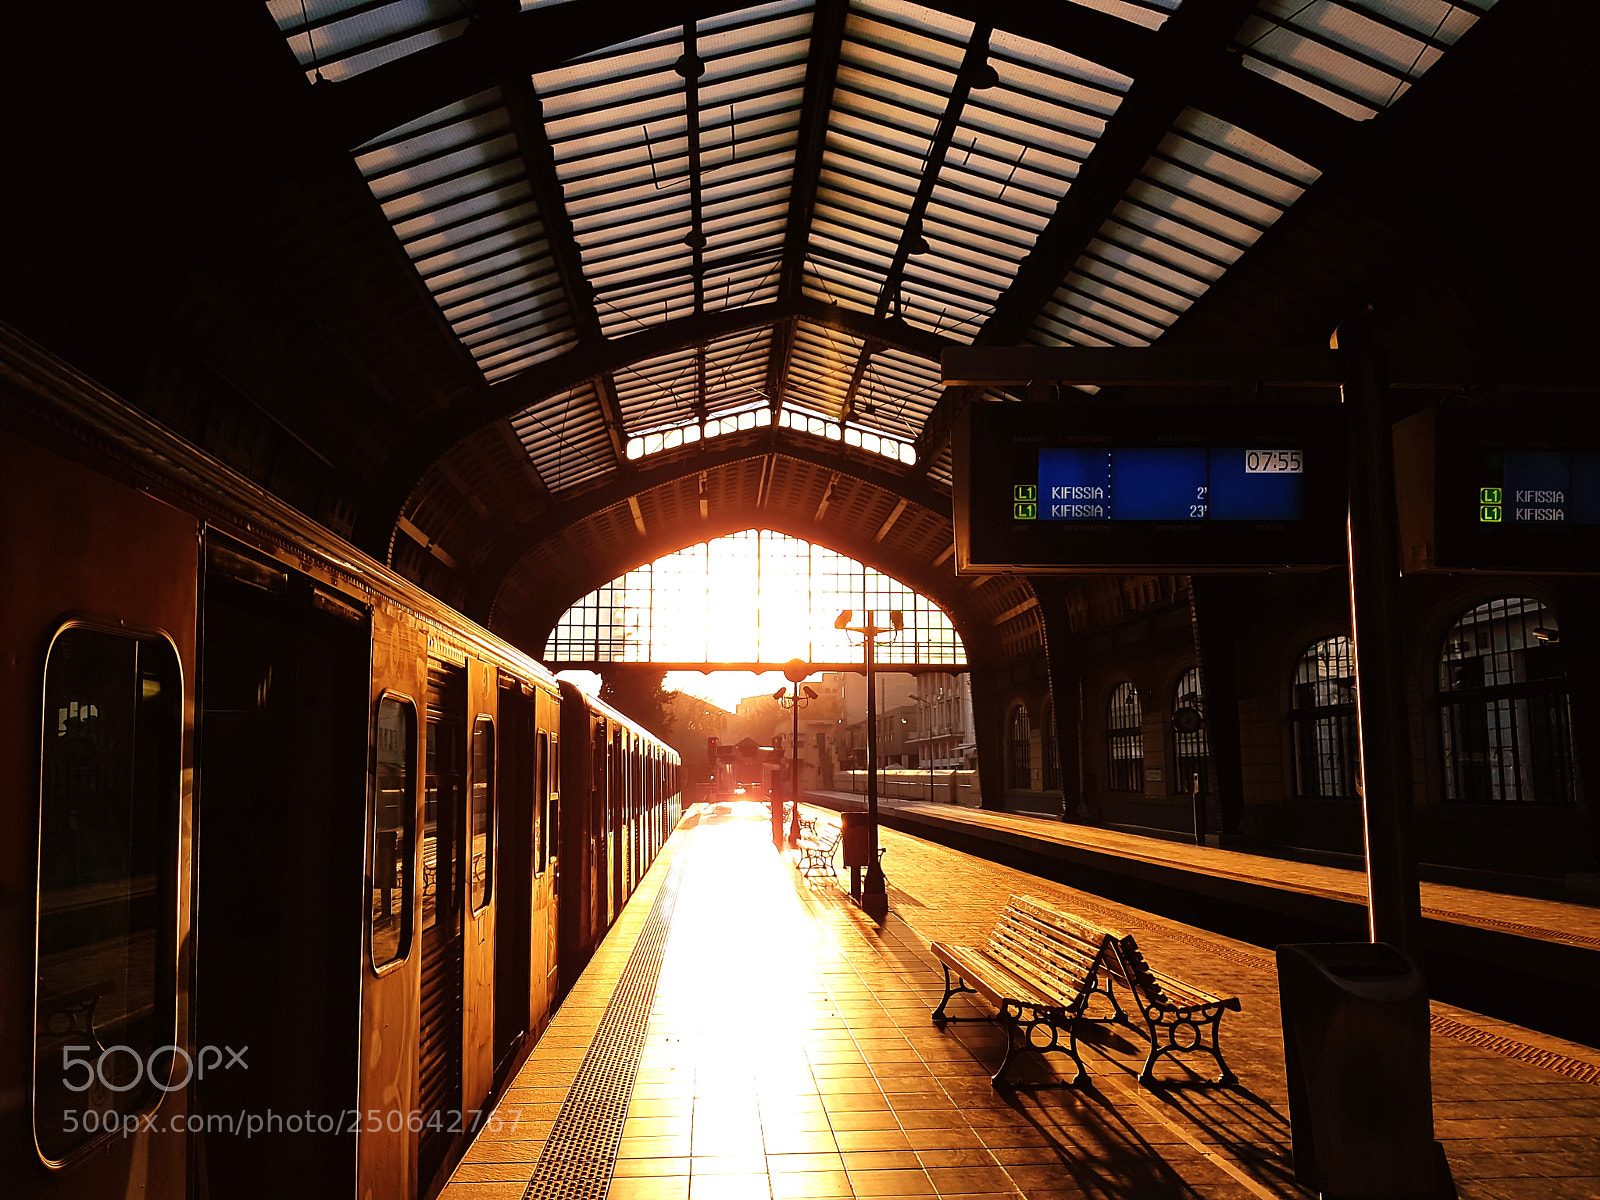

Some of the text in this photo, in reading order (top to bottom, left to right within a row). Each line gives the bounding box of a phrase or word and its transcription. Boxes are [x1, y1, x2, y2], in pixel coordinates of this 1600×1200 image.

[1247, 451, 1302, 472] 07:55
[1016, 486, 1035, 500] L1
[1051, 487, 1104, 500] KIFISSIA
[1481, 488, 1565, 504] L1 KIFISSIA
[1016, 504, 1035, 518] L1
[1051, 505, 1104, 518] KIFISSIA
[1481, 506, 1565, 521] L1 KIFISSIA
